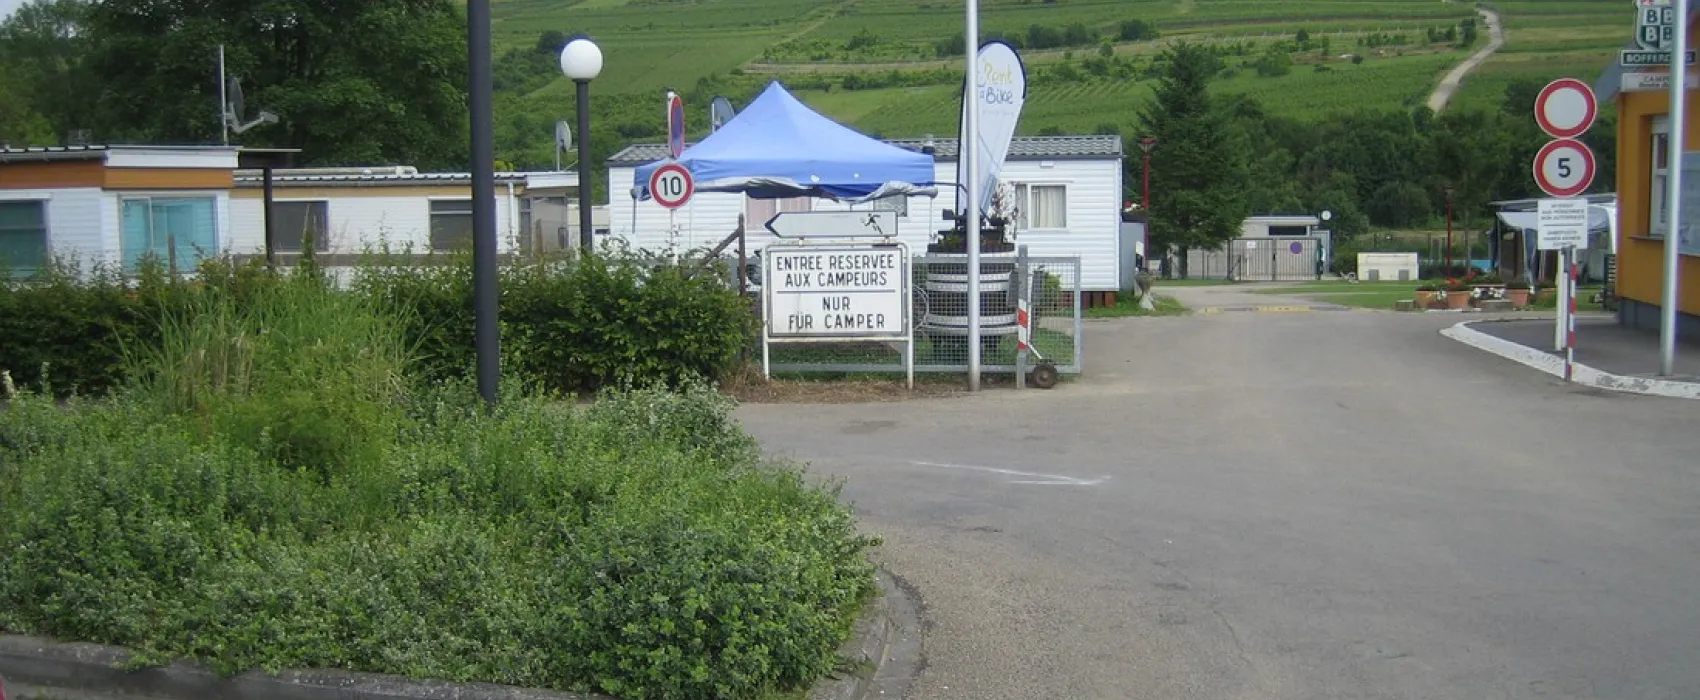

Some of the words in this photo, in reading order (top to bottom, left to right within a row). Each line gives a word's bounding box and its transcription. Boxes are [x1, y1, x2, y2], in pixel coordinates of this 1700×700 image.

[1647, 9, 1657, 23] B
[1645, 26, 1657, 41] B
[985, 86, 1013, 104] Bike
[1557, 157, 1571, 178] 5
[661, 176, 682, 196] 10
[776, 255, 823, 271] ENTREE
[829, 254, 895, 270] RESERVEE
[785, 273, 811, 287] AUX
[818, 271, 888, 286] CAMPEURS
[822, 296, 851, 311] NUR
[788, 311, 814, 330] FÜR
[824, 313, 885, 329] CAMPER
